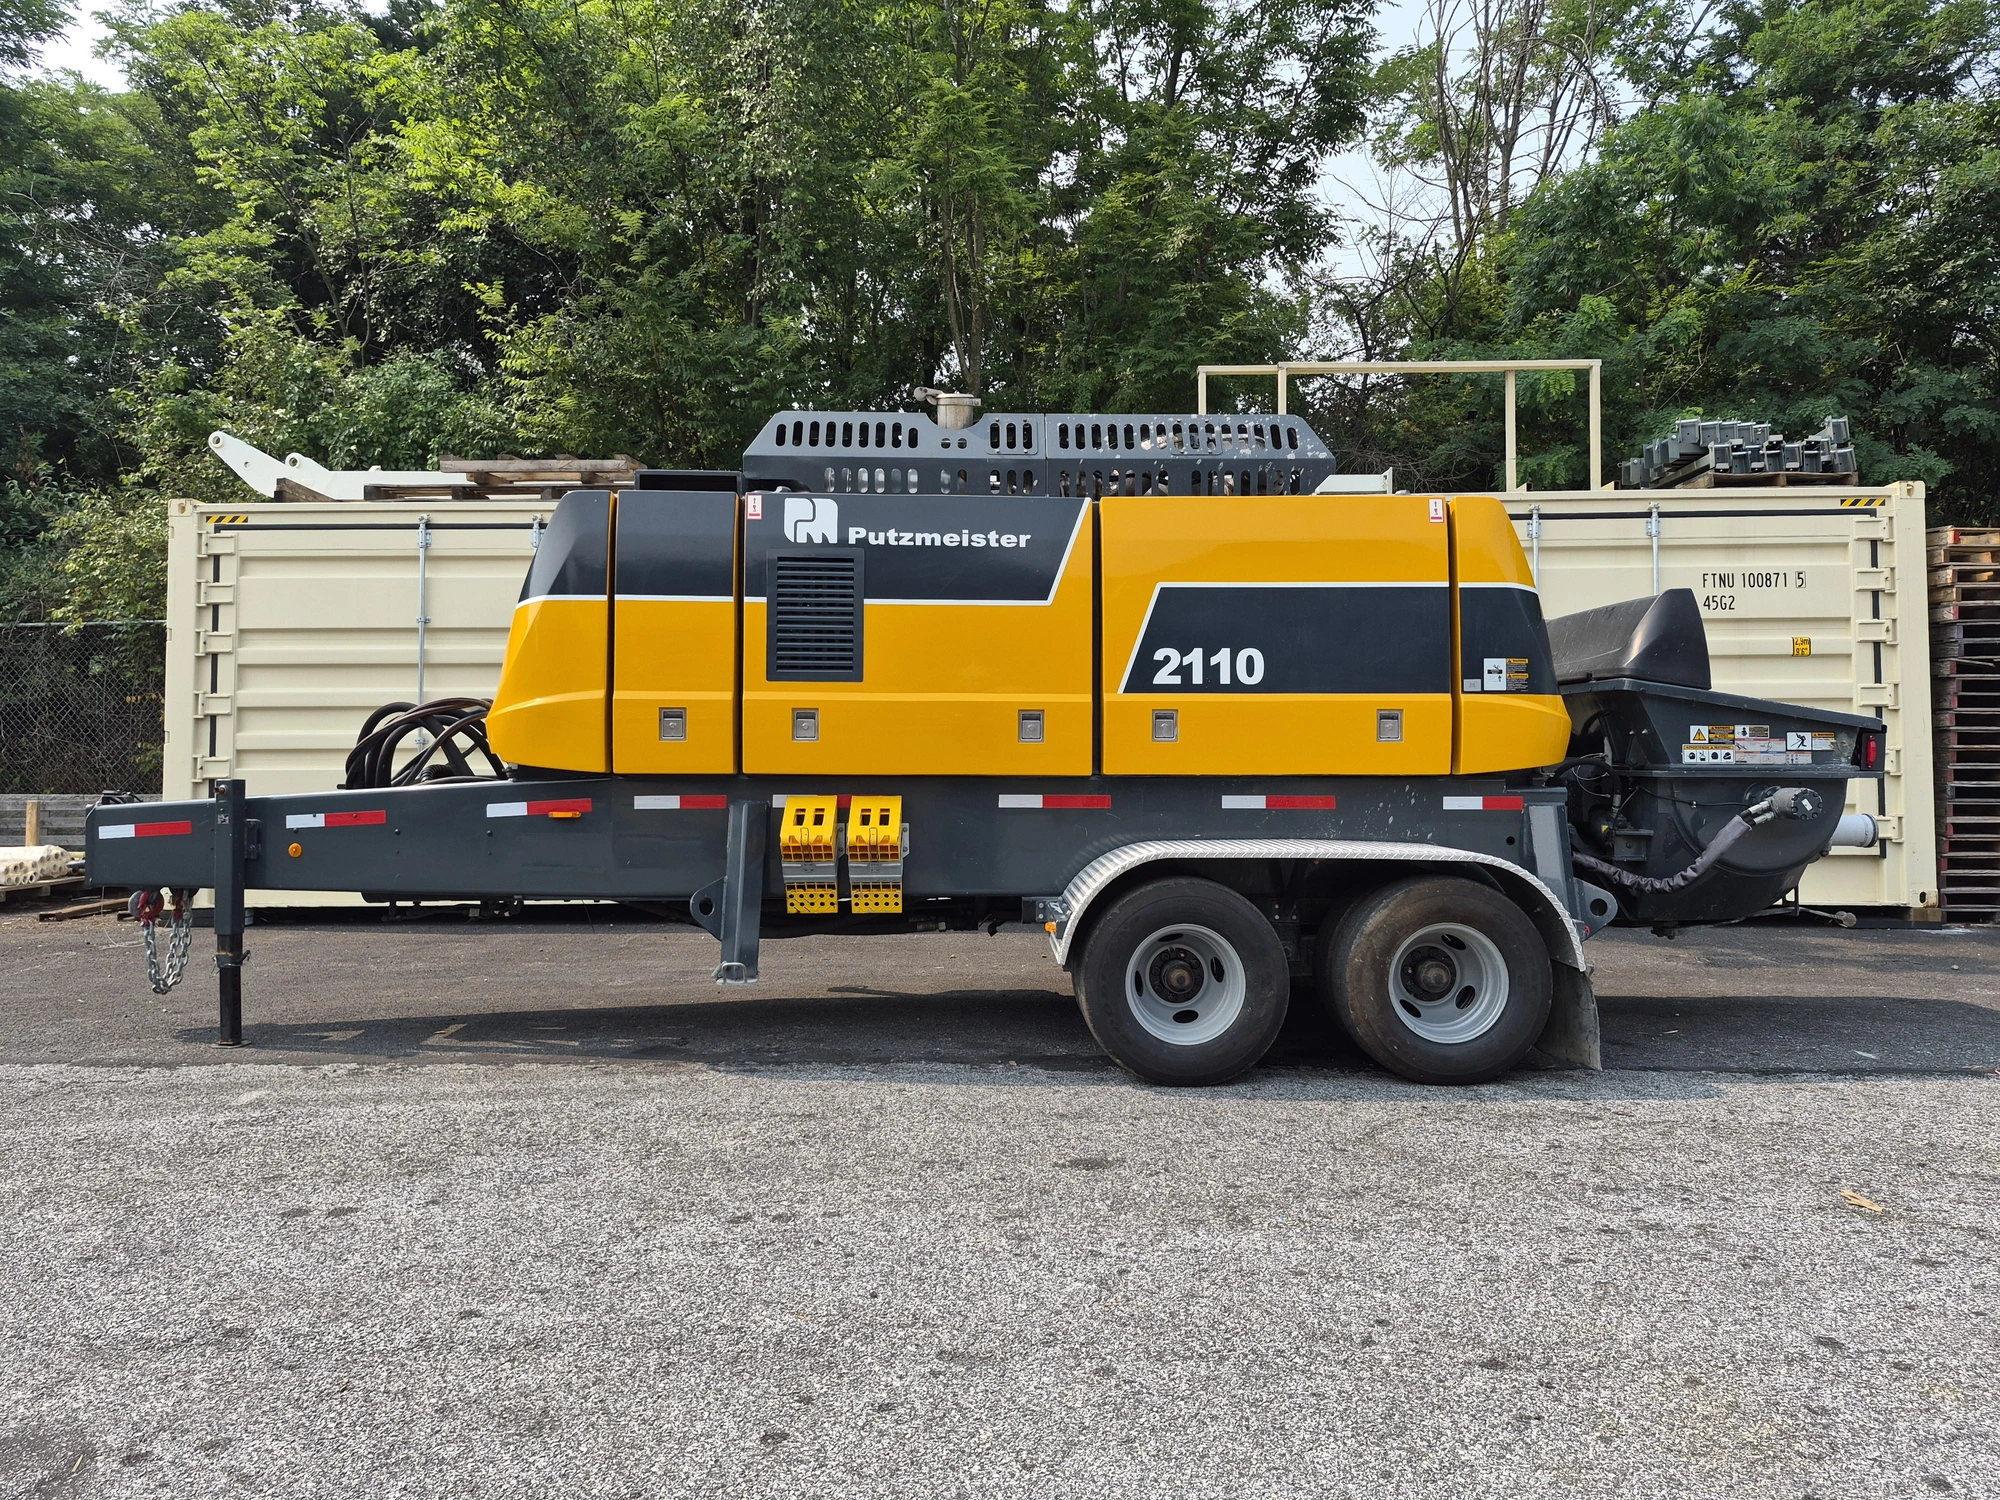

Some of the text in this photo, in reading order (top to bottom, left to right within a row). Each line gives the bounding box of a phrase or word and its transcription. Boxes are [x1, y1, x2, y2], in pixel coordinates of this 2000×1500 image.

[848, 527, 1031, 548] Putzmeister
[1702, 571, 1805, 588] FTNU 100871 5
[1702, 595, 1736, 610] 45G2
[1152, 647, 1265, 685] 2110
